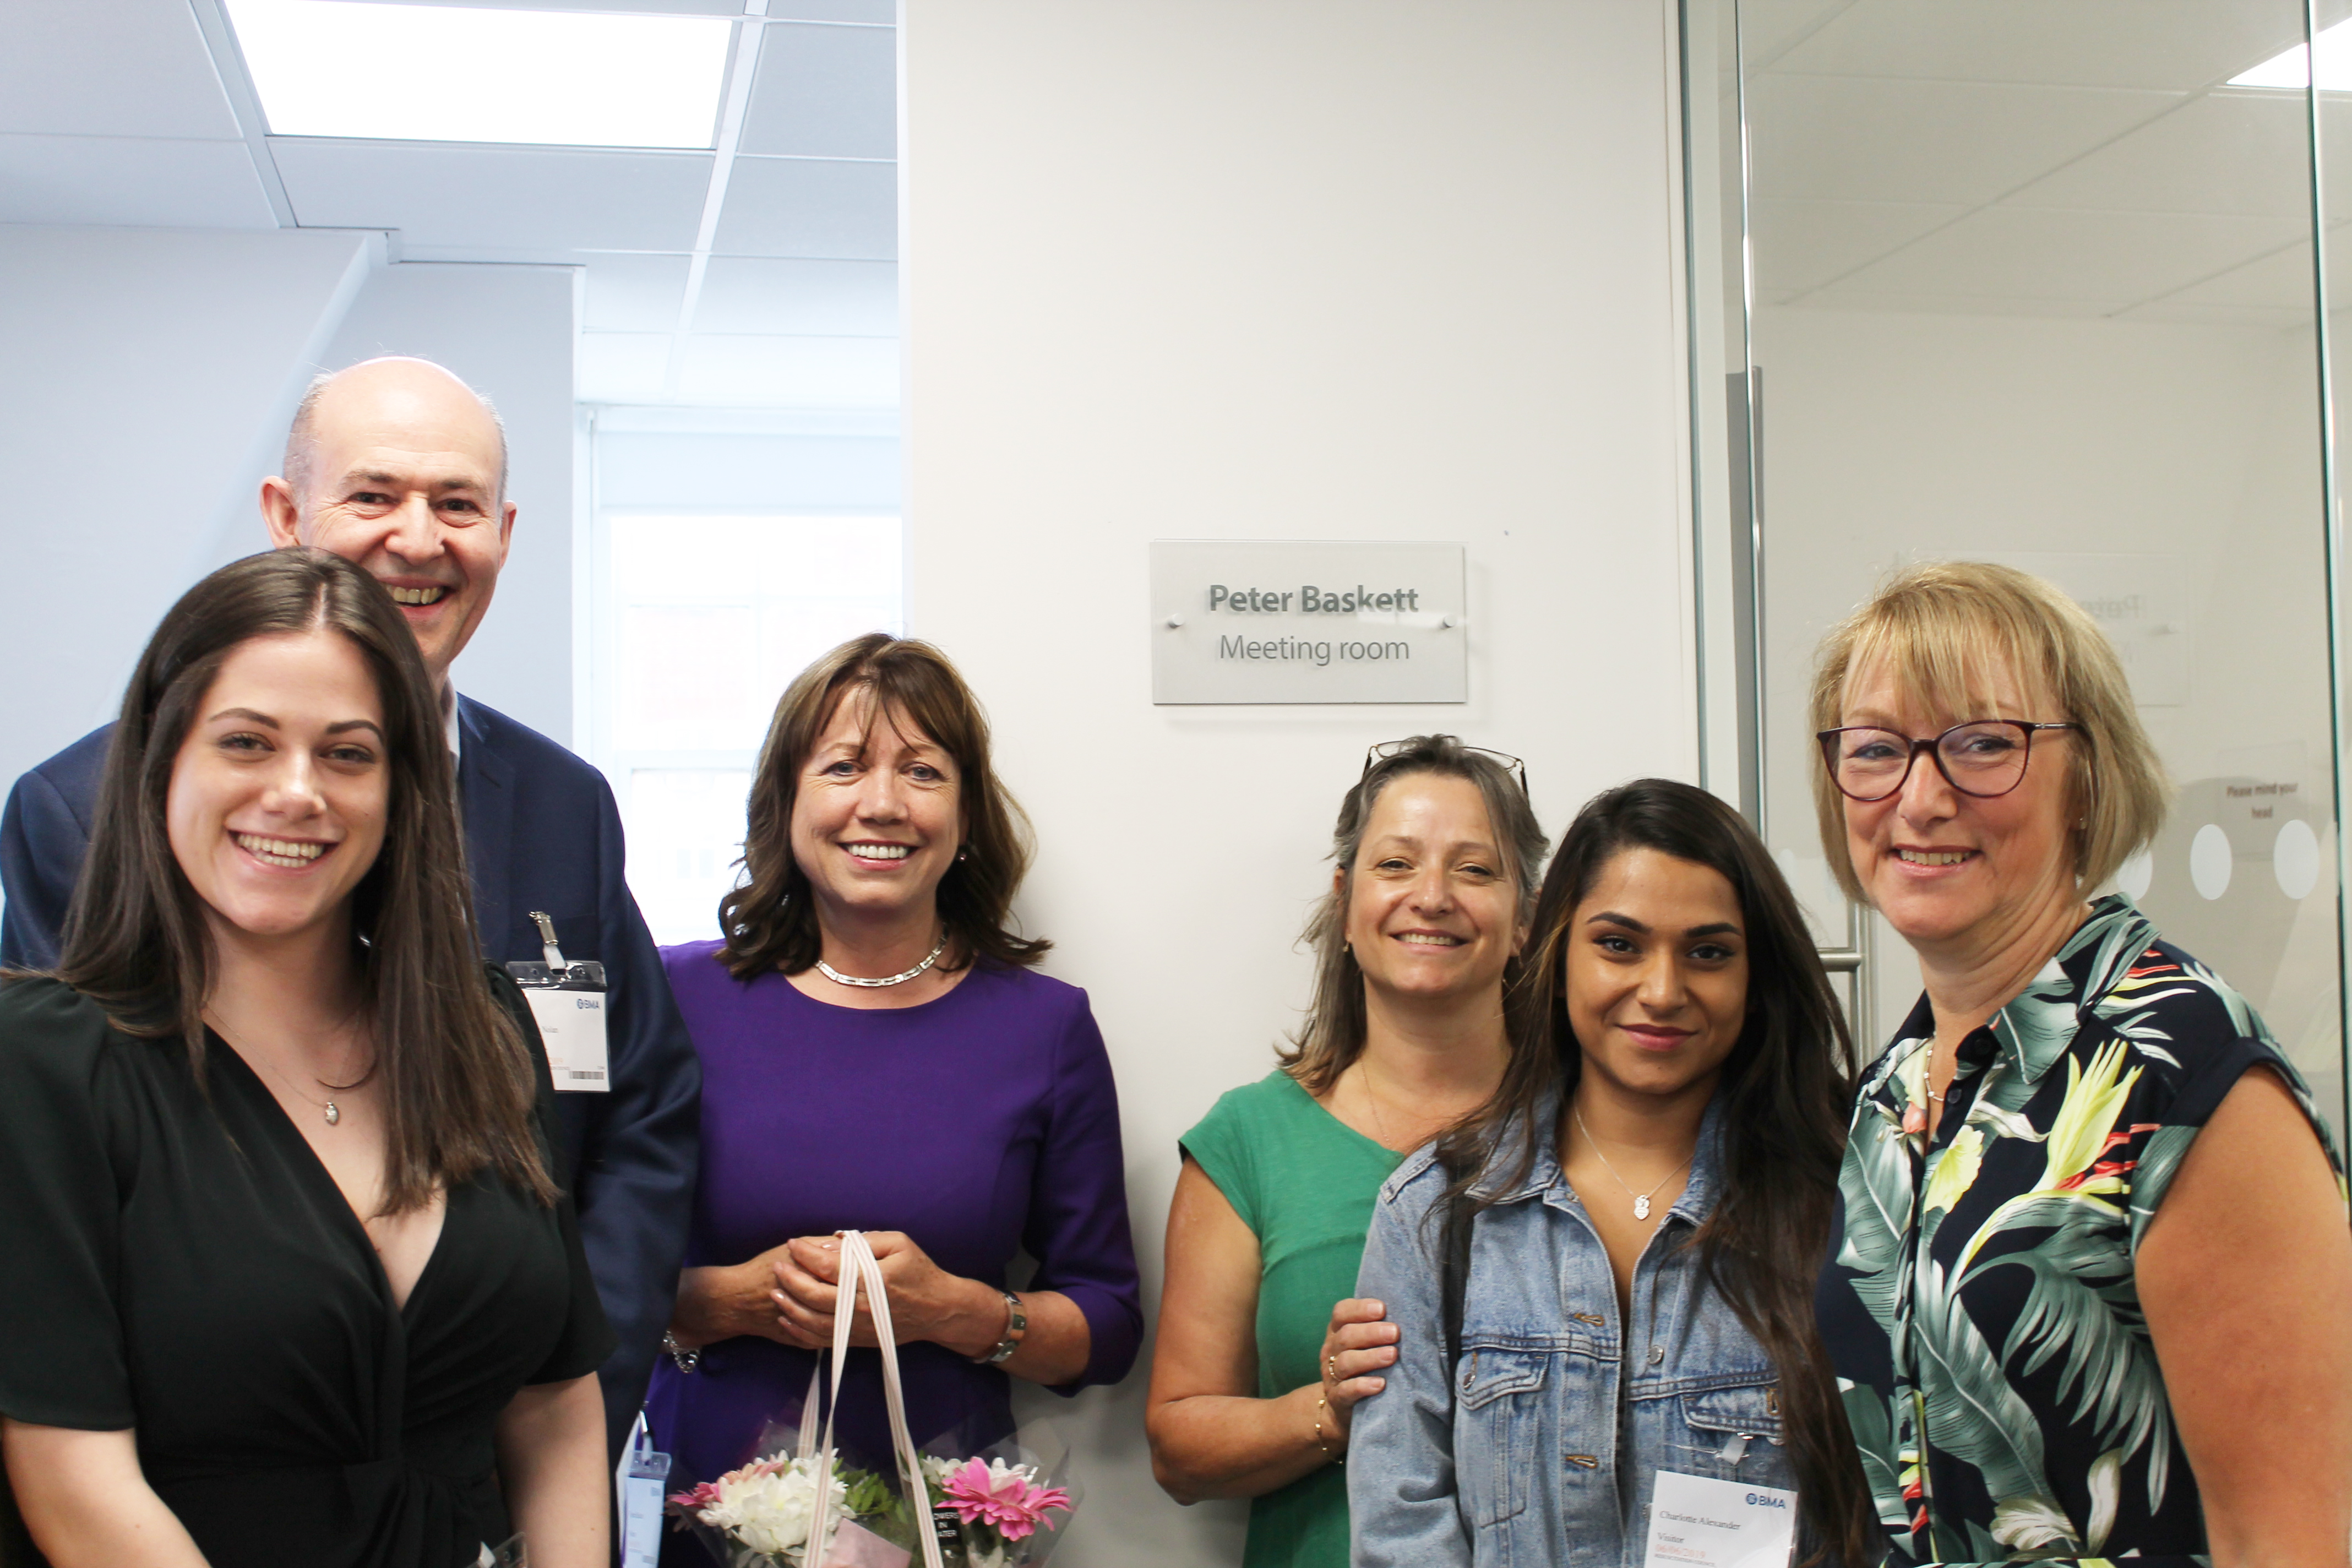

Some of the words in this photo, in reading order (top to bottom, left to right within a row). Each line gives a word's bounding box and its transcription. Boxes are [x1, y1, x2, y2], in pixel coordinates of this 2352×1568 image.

[1209, 585, 1293, 613] Peter
[1301, 585, 1419, 613] Baskett
[1219, 634, 1330, 667] Meeting
[1340, 640, 1410, 660] room
[2226, 785, 2252, 797] Please
[2255, 782, 2277, 794] mind
[2279, 782, 2299, 796] your
[2251, 805, 2273, 818] head
[584, 999, 601, 1009] BMA
[1757, 1495, 1787, 1509] BMA
[933, 1512, 960, 1520] OWERS
[1659, 1510, 1697, 1523] Charlotte
[1698, 1517, 1741, 1530] Alexander
[1657, 1532, 1685, 1544] Visitor
